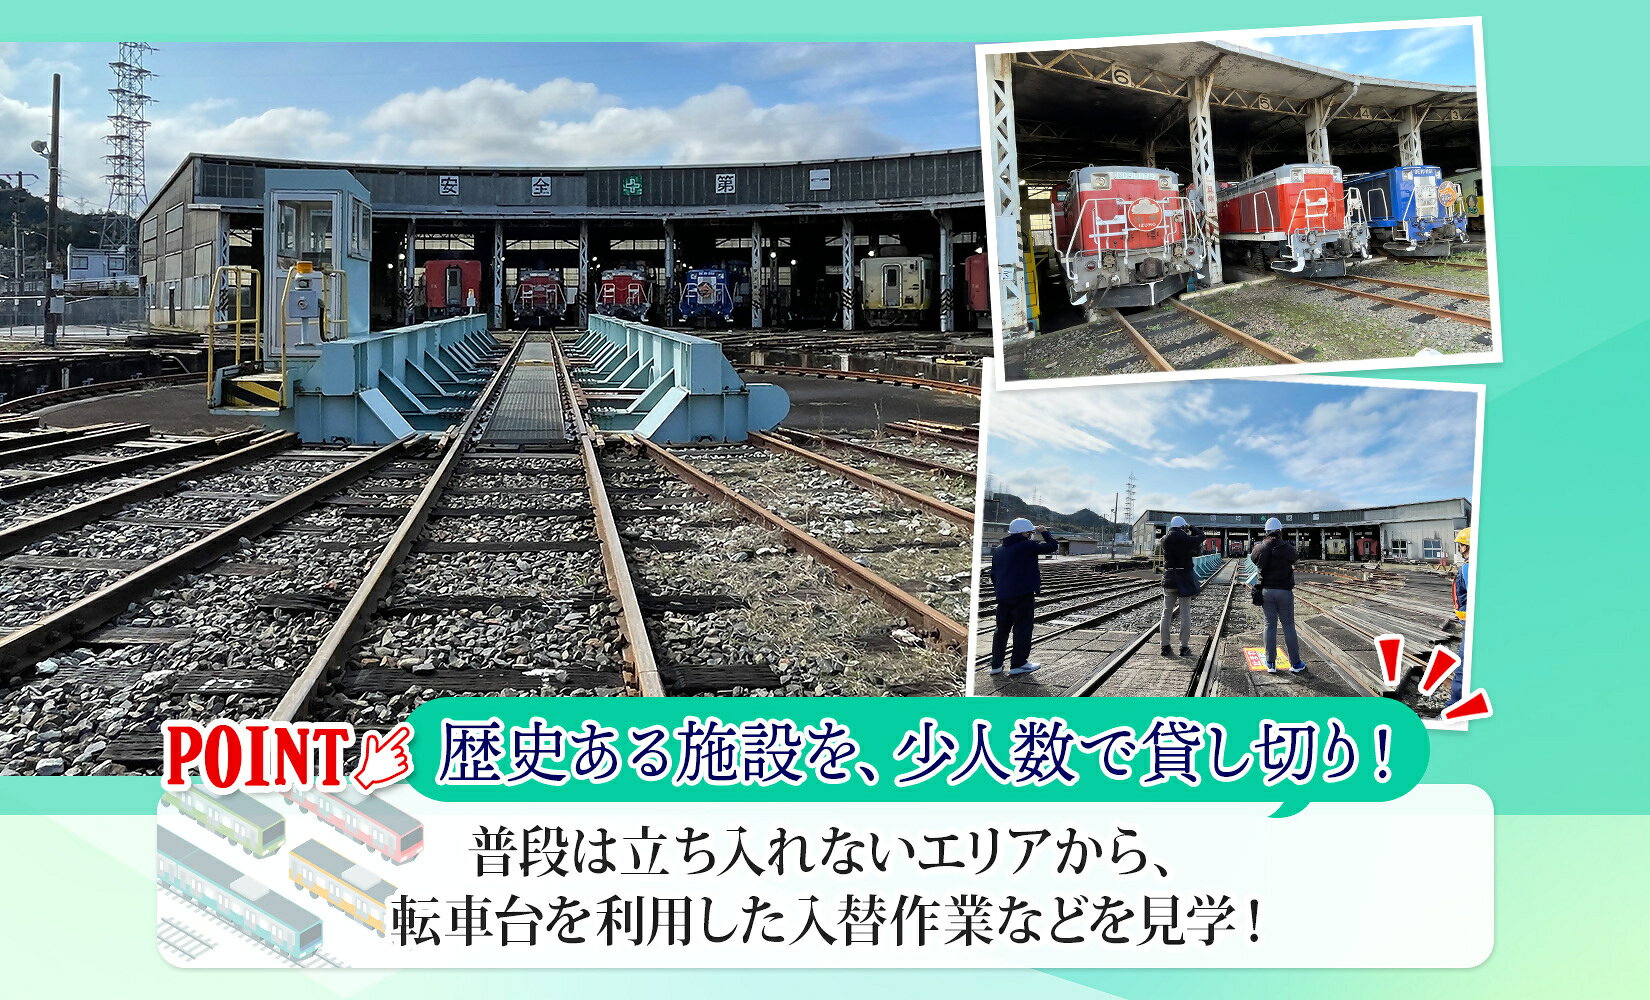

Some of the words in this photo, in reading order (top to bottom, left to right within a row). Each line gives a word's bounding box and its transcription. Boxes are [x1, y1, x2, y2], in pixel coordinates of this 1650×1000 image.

[1114, 69, 1129, 85] 6
[1260, 98, 1270, 109] 5
[1361, 109, 1370, 118] 4
[1452, 111, 1459, 119] 3
